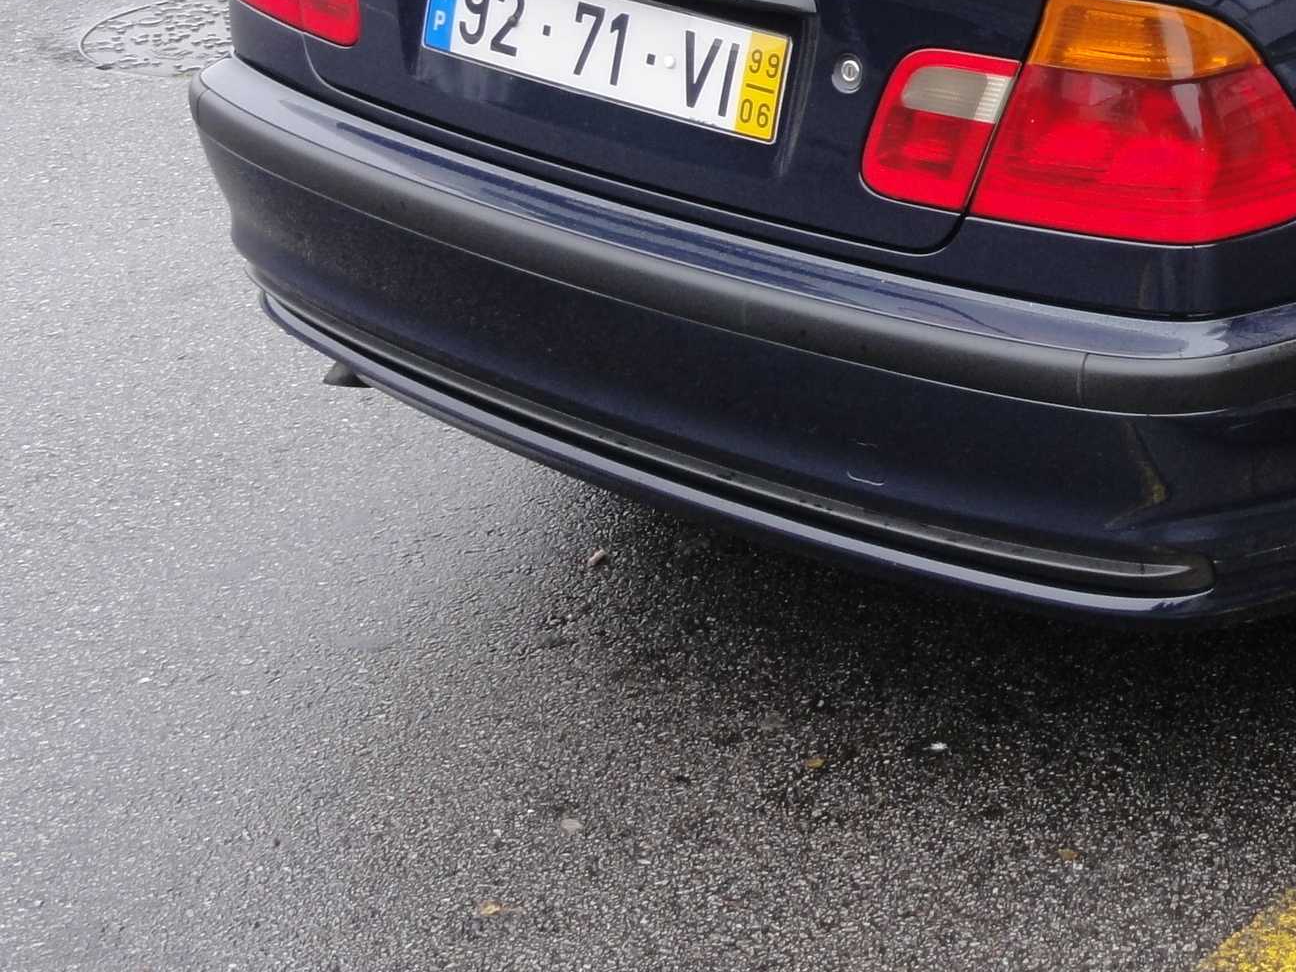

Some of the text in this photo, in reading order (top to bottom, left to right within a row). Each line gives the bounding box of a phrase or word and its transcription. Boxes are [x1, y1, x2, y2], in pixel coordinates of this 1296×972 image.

[434, 10, 446, 30] P
[749, 48, 780, 78] 99
[740, 98, 771, 128] 06
